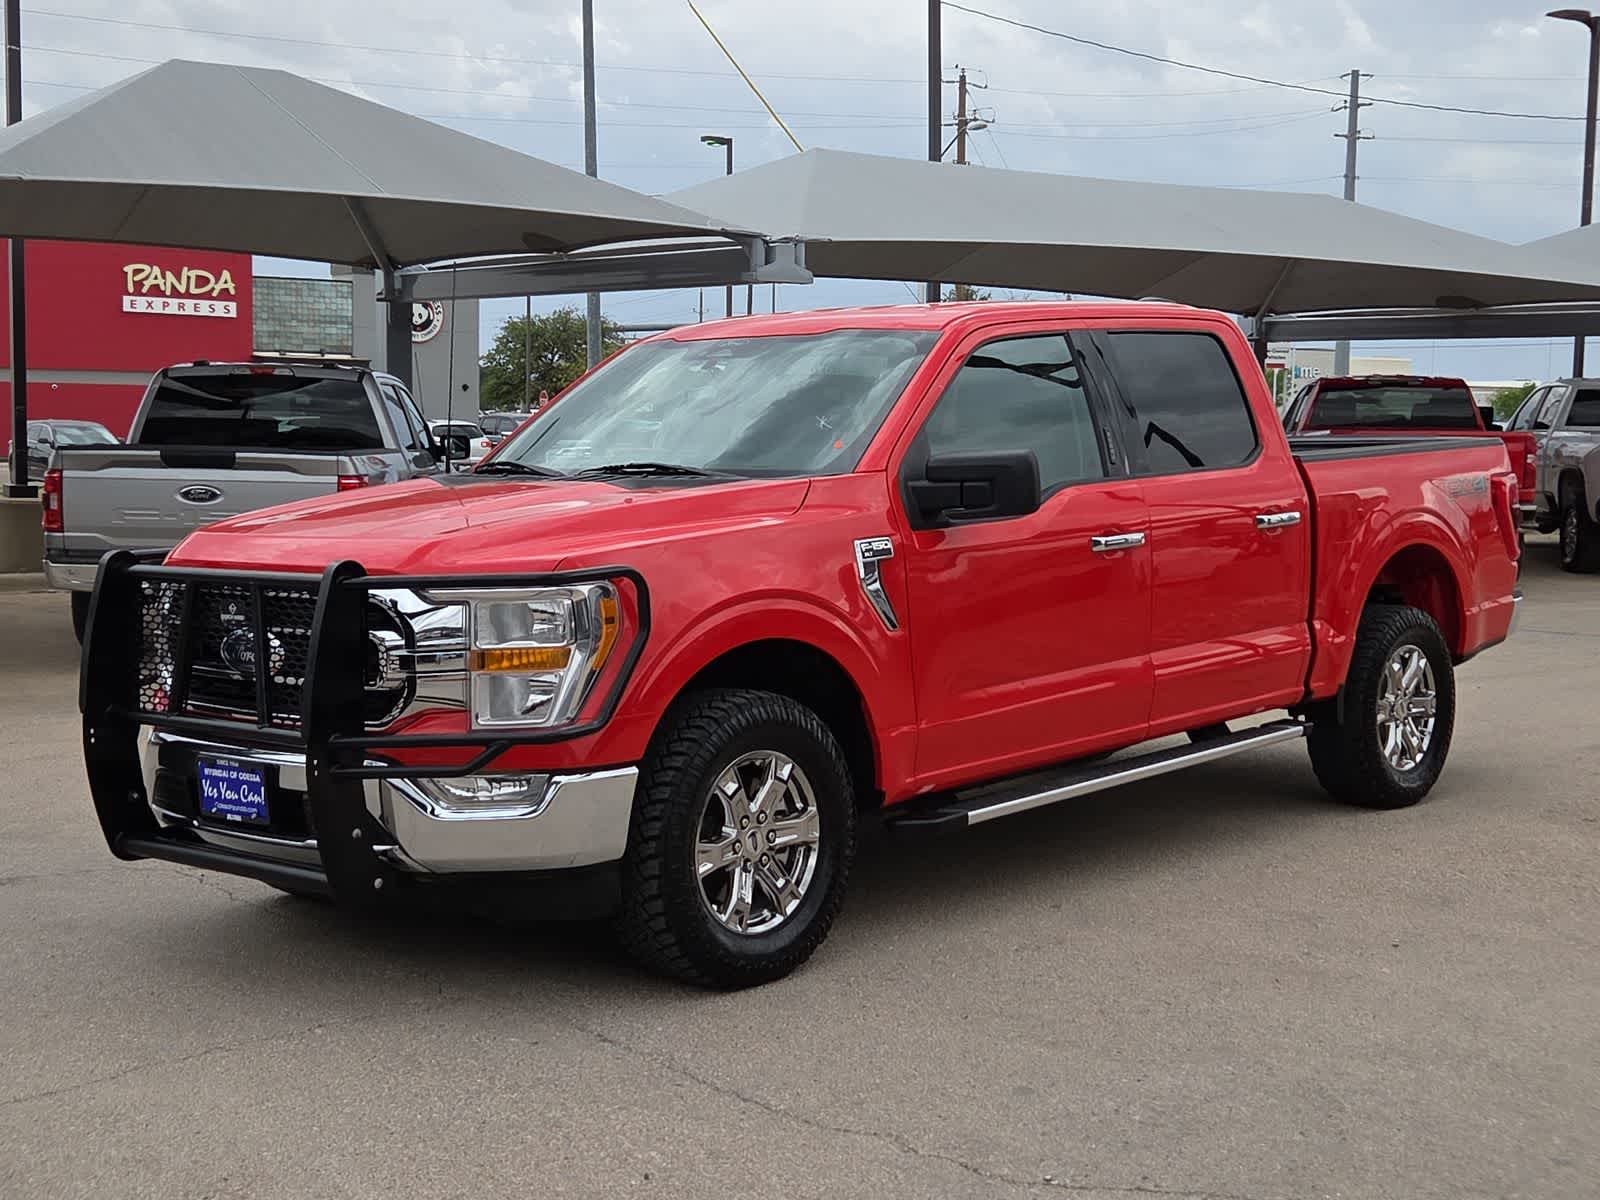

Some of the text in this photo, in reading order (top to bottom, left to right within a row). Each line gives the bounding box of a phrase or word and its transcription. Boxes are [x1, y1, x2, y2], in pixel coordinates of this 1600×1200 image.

[122, 263, 236, 297] PANDA
[125, 299, 231, 314] EXPRESS
[202, 779, 265, 805] Yes You Can!
